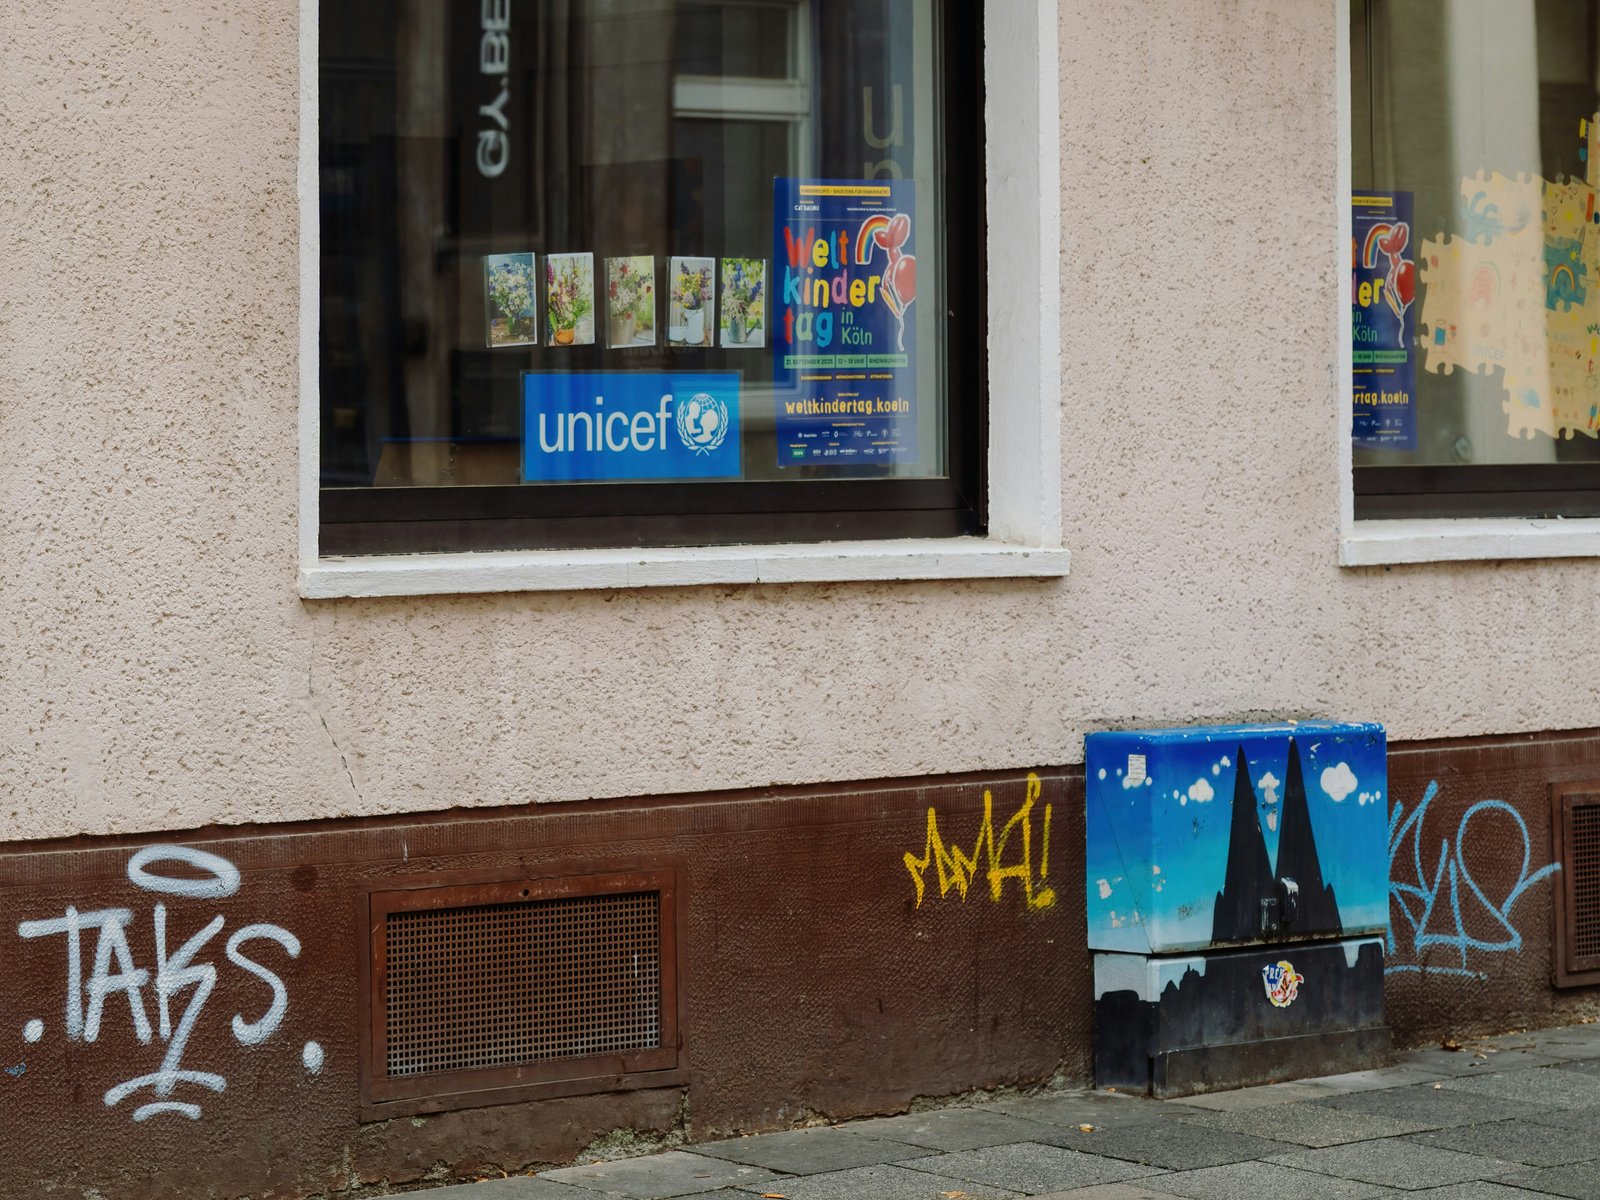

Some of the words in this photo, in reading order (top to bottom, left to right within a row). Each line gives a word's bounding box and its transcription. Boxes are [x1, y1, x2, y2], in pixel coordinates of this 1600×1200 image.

[783, 226, 849, 269] Welt
[783, 266, 882, 308] kinder
[784, 307, 834, 348] tag
[841, 307, 854, 324] in
[841, 326, 873, 346] Köln
[539, 394, 673, 453] unicef
[785, 397, 909, 414] weltkindertag.koeln
